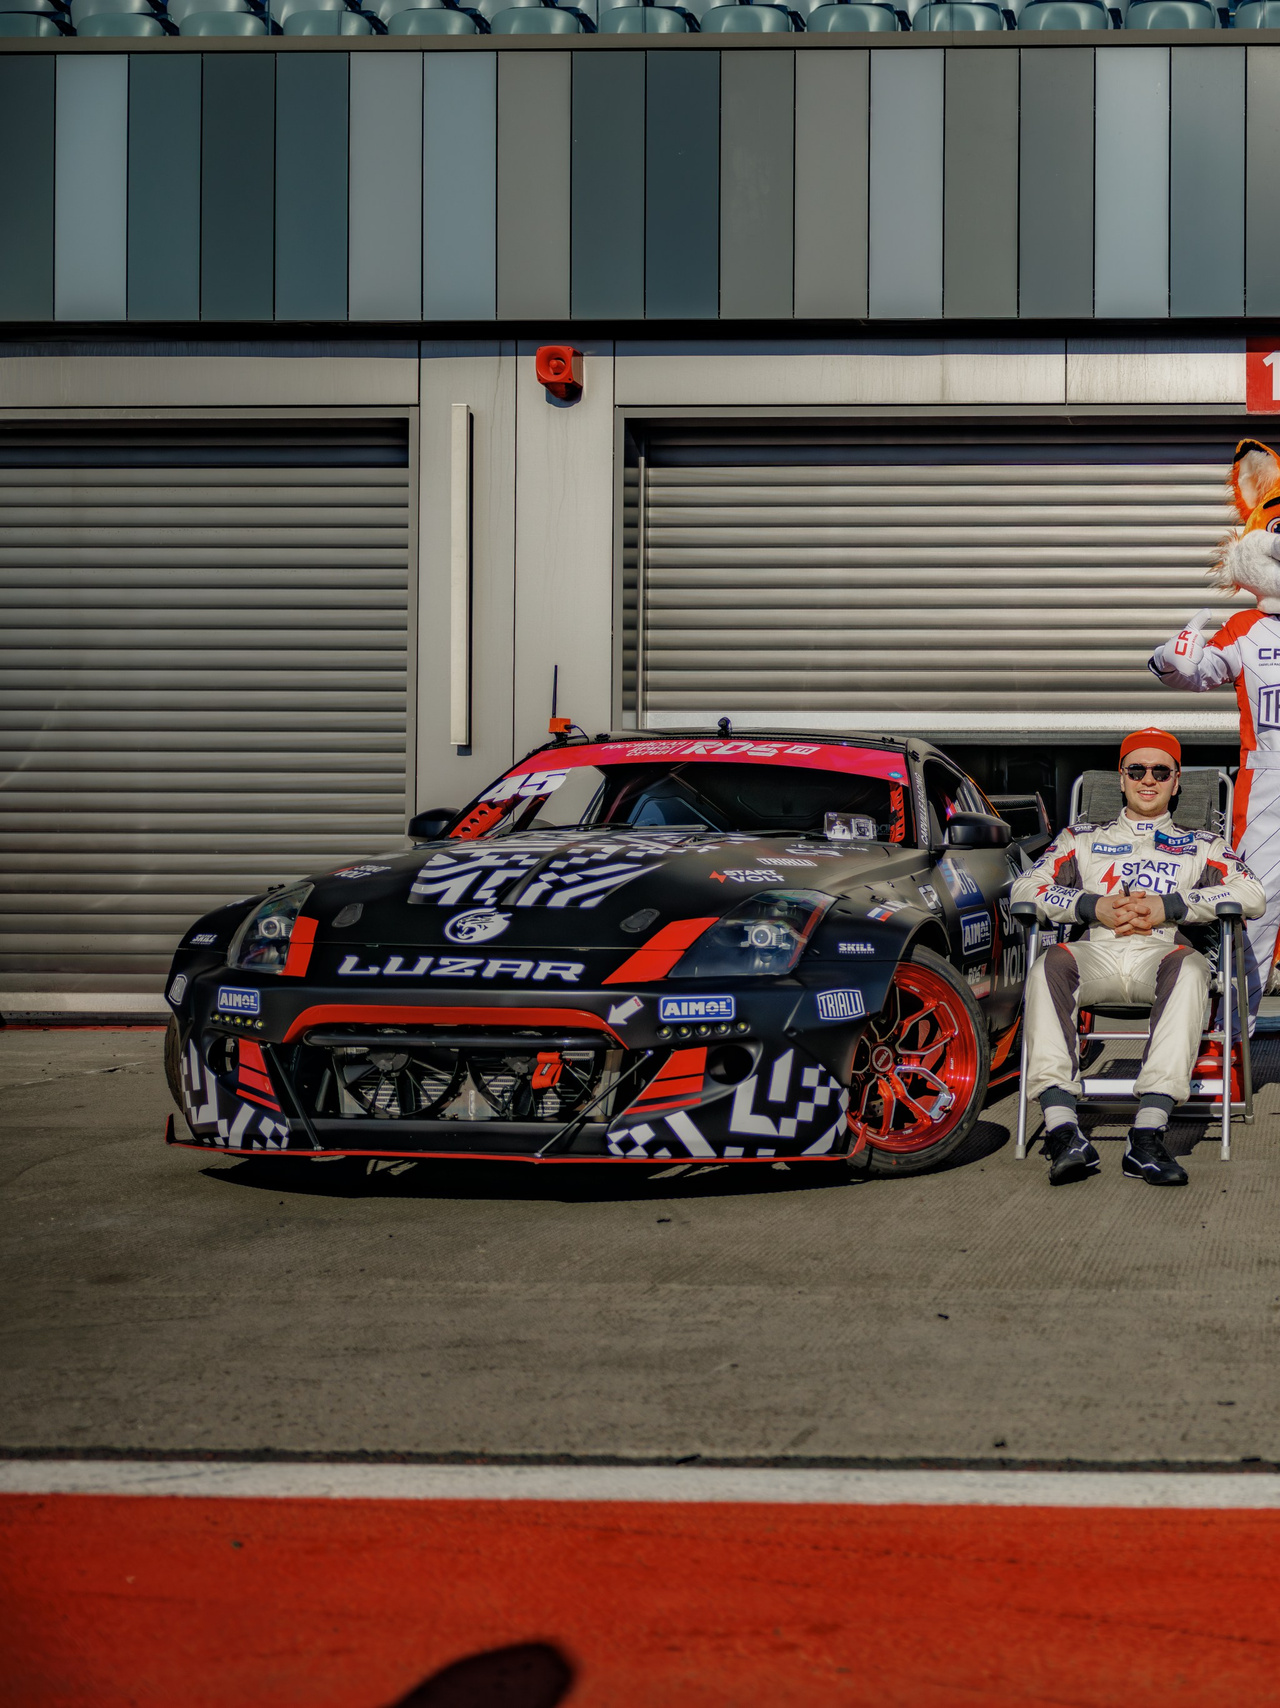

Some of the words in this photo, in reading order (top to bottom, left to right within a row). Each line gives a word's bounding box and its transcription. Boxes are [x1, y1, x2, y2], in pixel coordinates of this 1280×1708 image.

[1174, 630, 1192, 656] CR
[680, 742, 790, 757] RDS
[477, 768, 572, 802] 45
[915, 772, 925, 801] RACING
[919, 801, 928, 845] CARVILLE
[1094, 844, 1132, 853] AIMOL
[1168, 837, 1191, 845] ВТБ
[1121, 859, 1181, 877] START
[1050, 885, 1079, 897] START
[1044, 892, 1072, 909] VOLT
[964, 921, 990, 948] AIMOL
[838, 943, 875, 951] SKILL
[337, 955, 586, 982] LUZAR
[220, 992, 258, 1009] AIMOL
[663, 1001, 731, 1016] AIMOL
[820, 990, 863, 1018] TRIALLI
